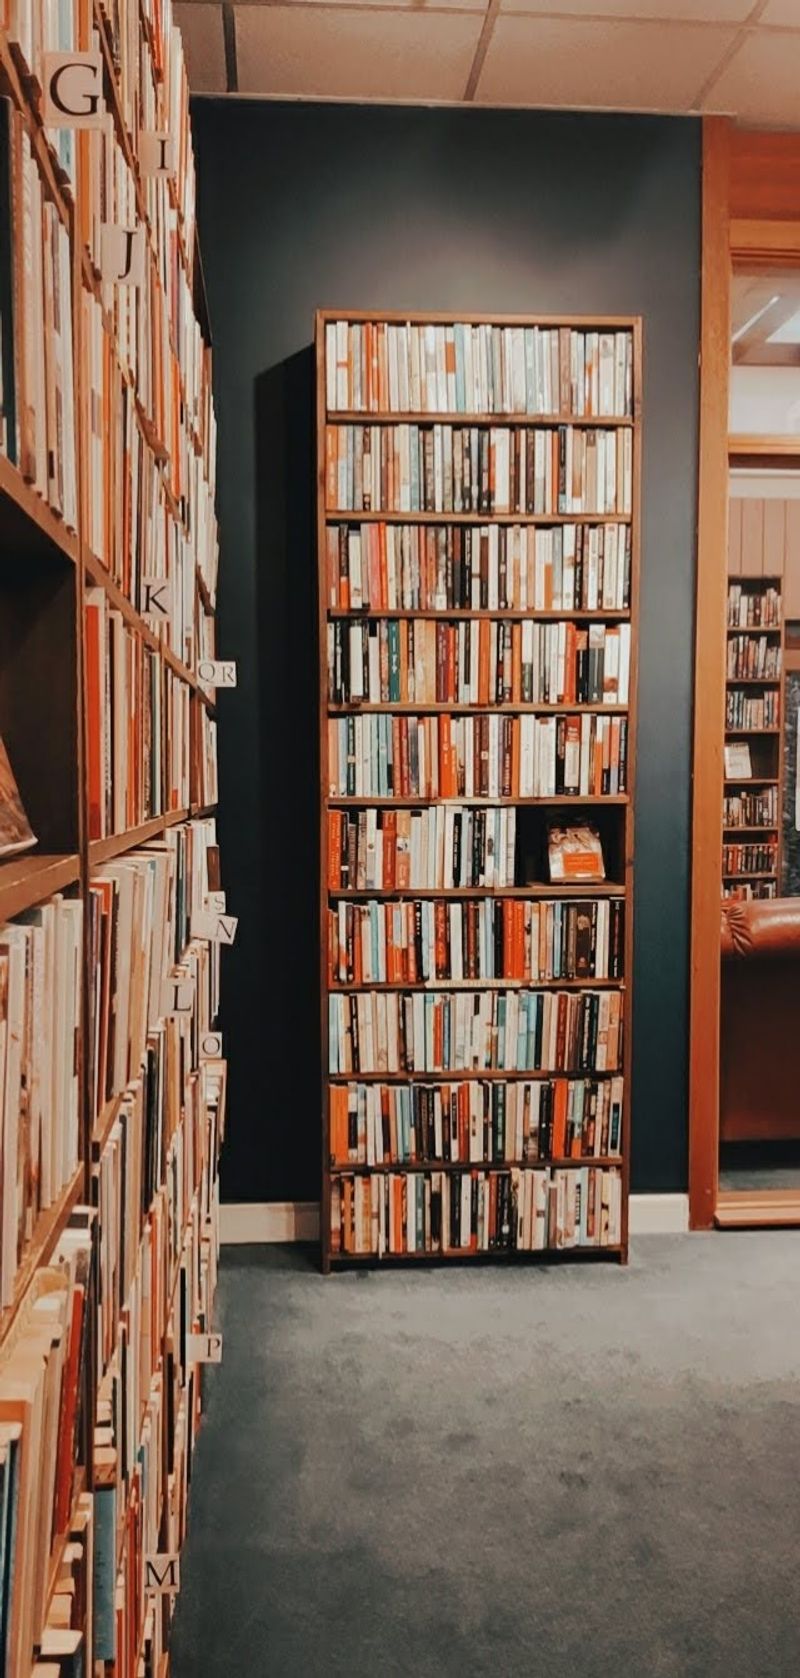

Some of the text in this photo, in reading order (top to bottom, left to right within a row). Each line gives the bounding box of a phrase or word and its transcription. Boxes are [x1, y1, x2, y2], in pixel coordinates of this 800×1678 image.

[50, 63, 99, 116] G
[158, 139, 169, 170] I
[118, 231, 137, 279] J
[143, 585, 168, 614] K
[215, 896, 224, 910] S
[216, 919, 235, 938] N
[173, 985, 191, 1011] L
[202, 1036, 220, 1055] O
[207, 1338, 221, 1357] P
[144, 1561, 177, 1587] M
